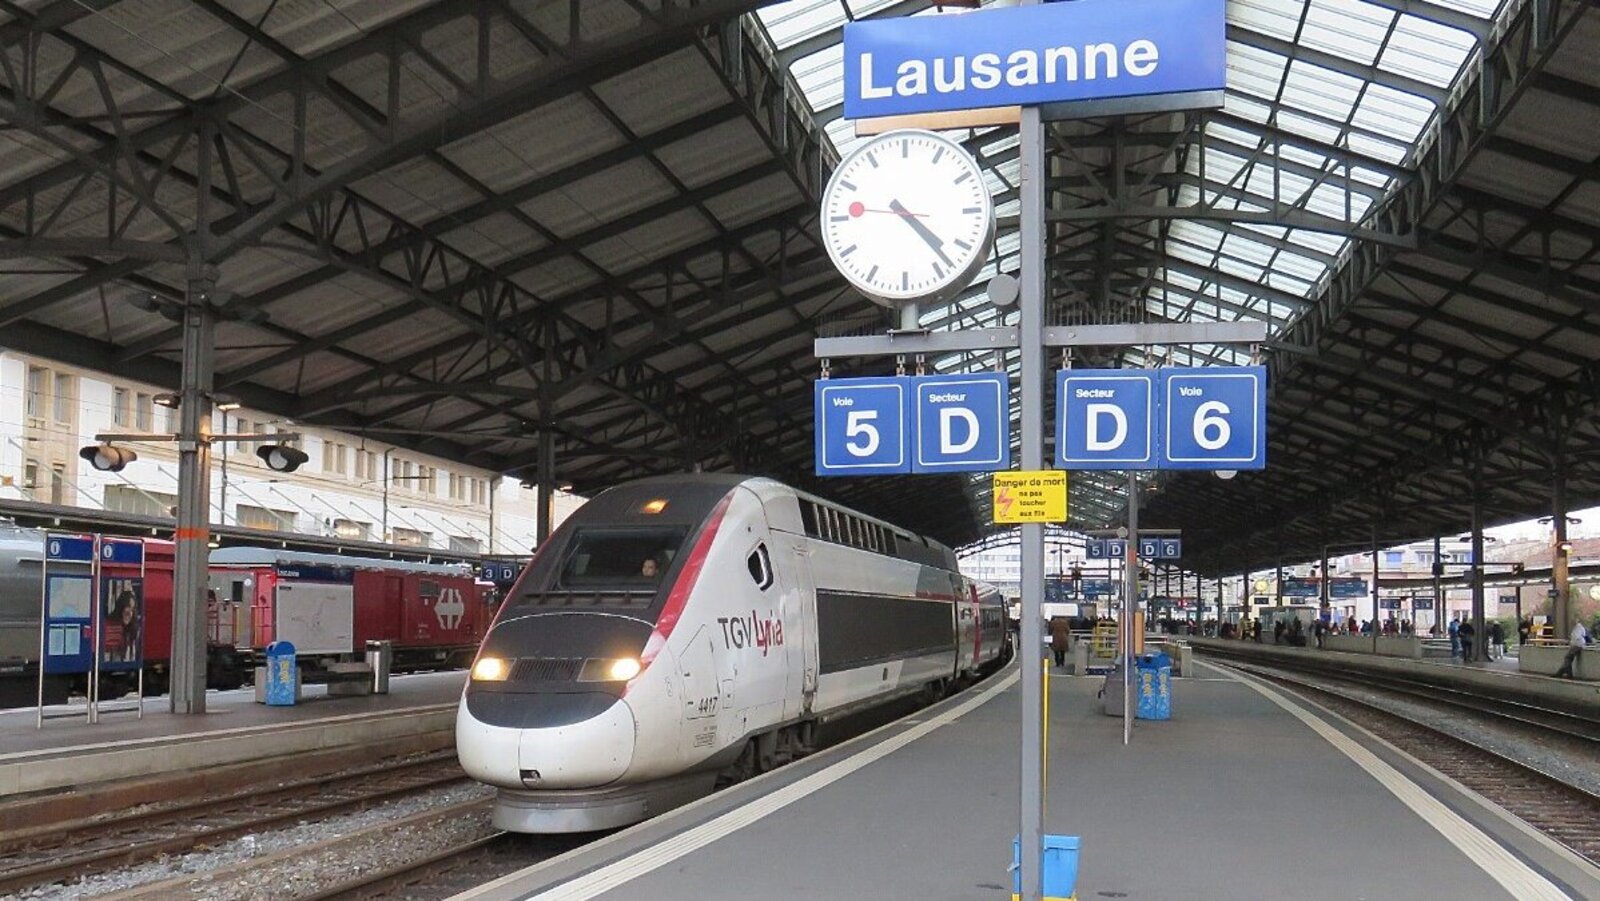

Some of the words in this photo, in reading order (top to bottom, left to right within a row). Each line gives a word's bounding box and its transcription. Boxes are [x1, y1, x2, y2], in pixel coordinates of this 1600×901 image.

[860, 38, 1159, 100] Lausanne
[1076, 388, 1115, 398] Secteur
[1179, 387, 1203, 397] Voie
[833, 397, 854, 407] Voie
[929, 393, 967, 403] Secteur
[940, 407, 980, 454] D
[1086, 403, 1128, 451] D
[1193, 400, 1231, 450] 6
[846, 410, 880, 457] 5
[995, 478, 1027, 489] Danger
[1029, 477, 1042, 487] de
[1043, 478, 1065, 486] mort
[1091, 545, 1100, 556] 5
[1112, 545, 1121, 556] D
[1145, 545, 1155, 556] D
[1166, 545, 1175, 556] 6
[485, 569, 493, 579] 3
[503, 569, 513, 579] D
[717, 616, 752, 650] TGV
[752, 609, 784, 657] Lyria
[698, 696, 718, 714] 4417
